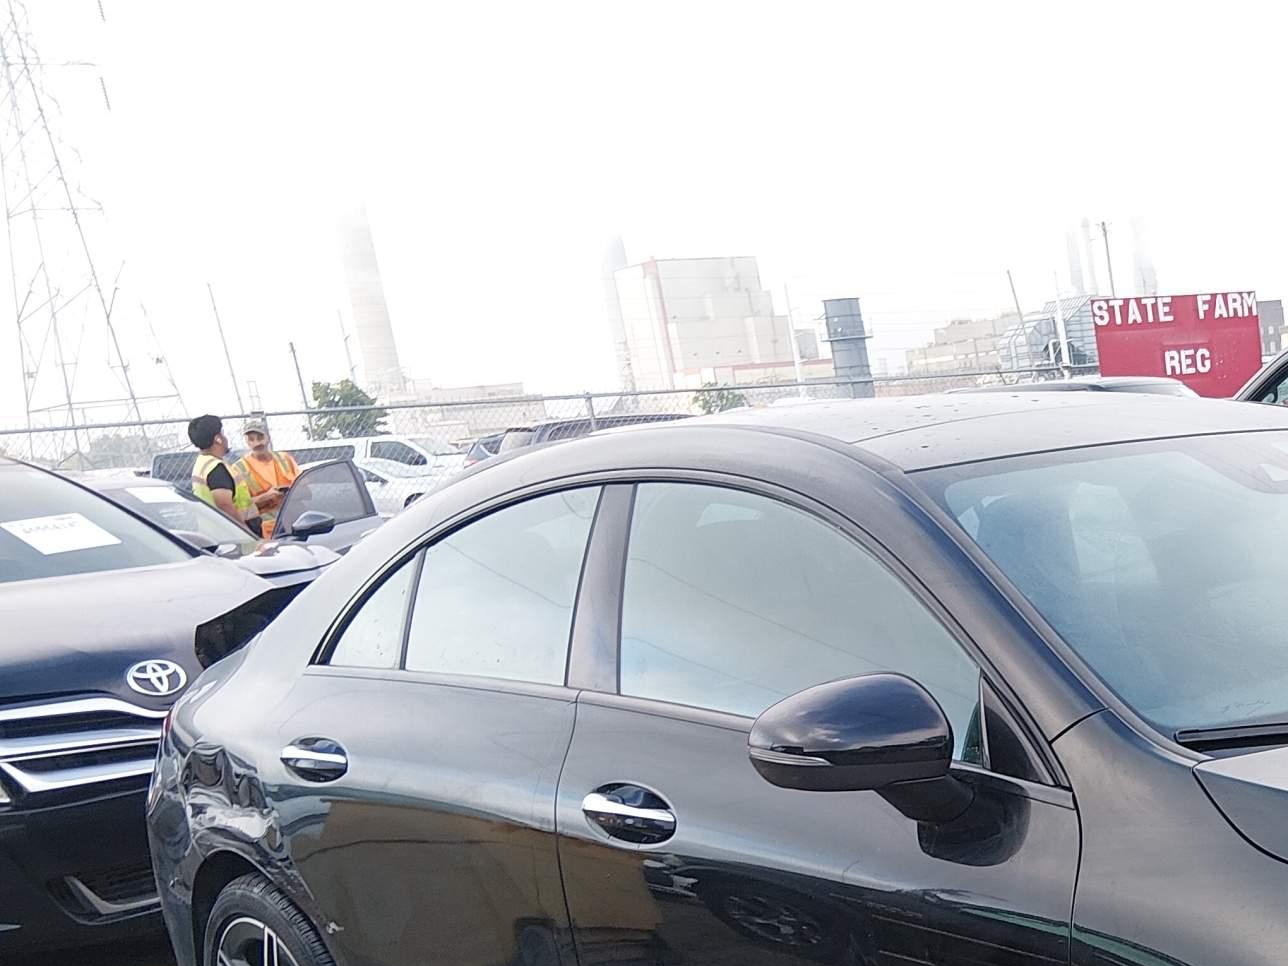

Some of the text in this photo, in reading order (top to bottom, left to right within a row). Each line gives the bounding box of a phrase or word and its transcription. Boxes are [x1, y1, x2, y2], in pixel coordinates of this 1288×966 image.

[1092, 293, 1258, 326] STATE FARM
[1164, 348, 1211, 376] REG
